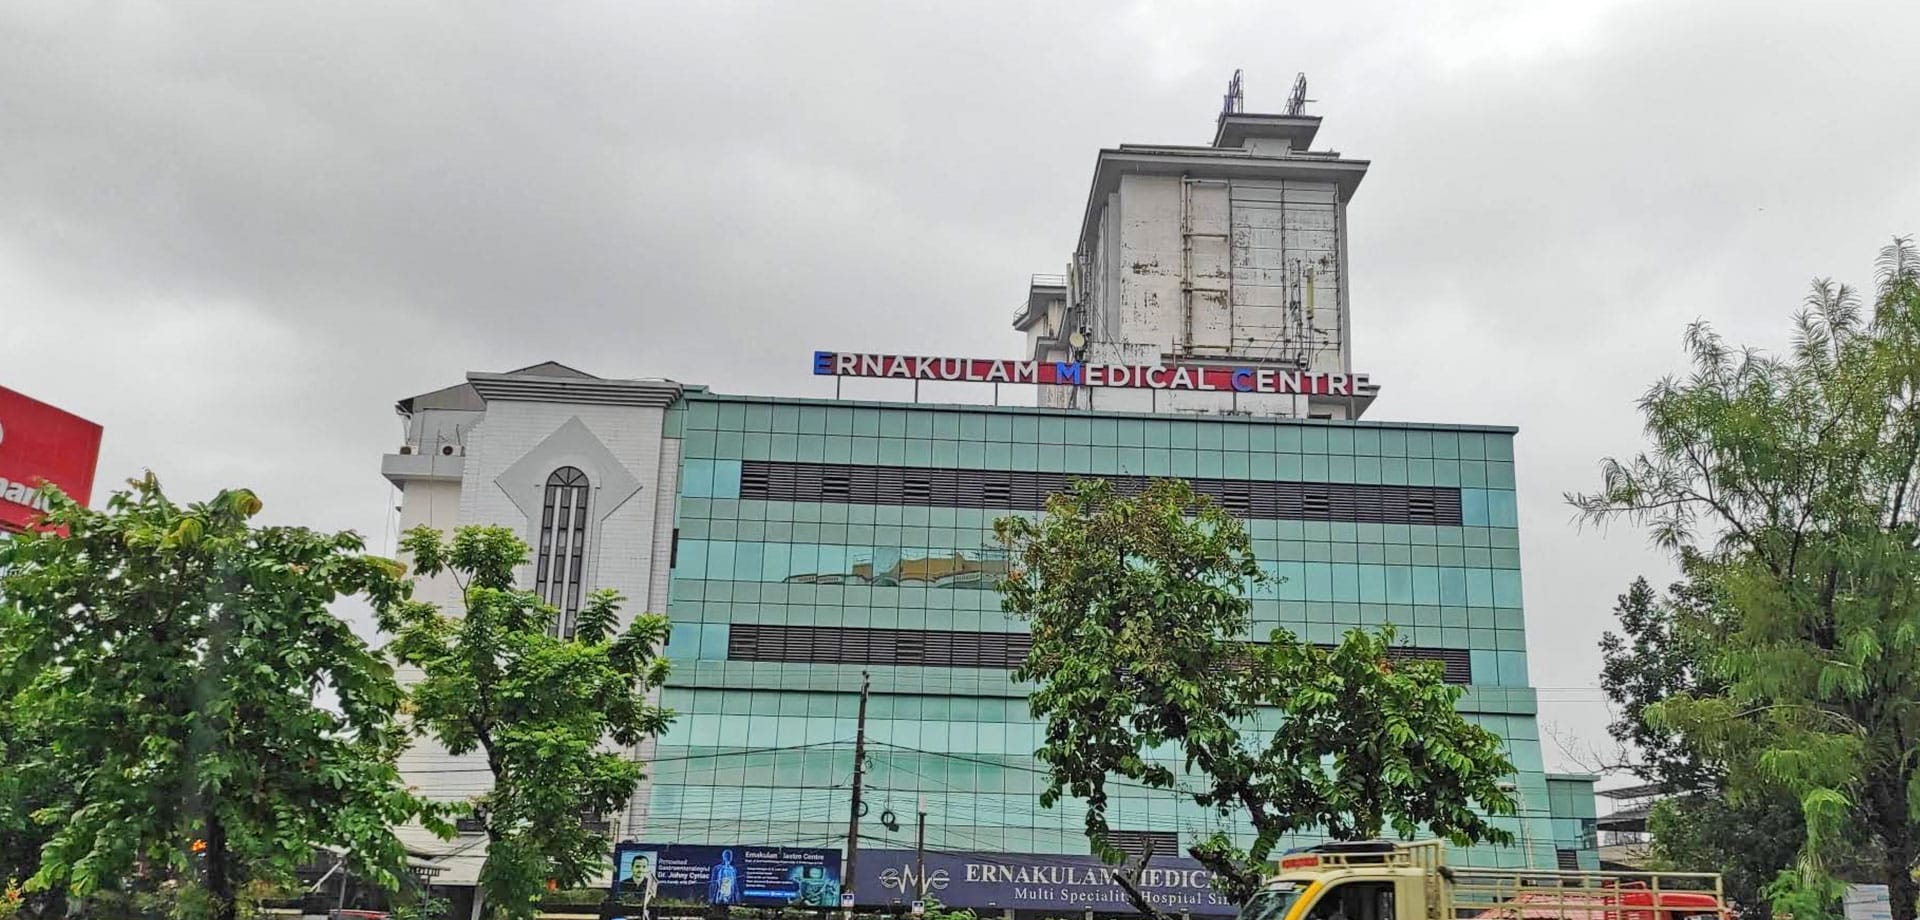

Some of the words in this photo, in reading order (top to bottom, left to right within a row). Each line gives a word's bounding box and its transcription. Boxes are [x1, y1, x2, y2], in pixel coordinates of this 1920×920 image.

[814, 351, 1039, 383] ERNAKULAM
[1056, 361, 1216, 390] MEDICAL
[1231, 367, 1371, 397] CENTRE
[964, 863, 1120, 886] ERNAKULAM
[1014, 887, 1054, 900] Multi
[1141, 891, 1201, 907] Hospital
